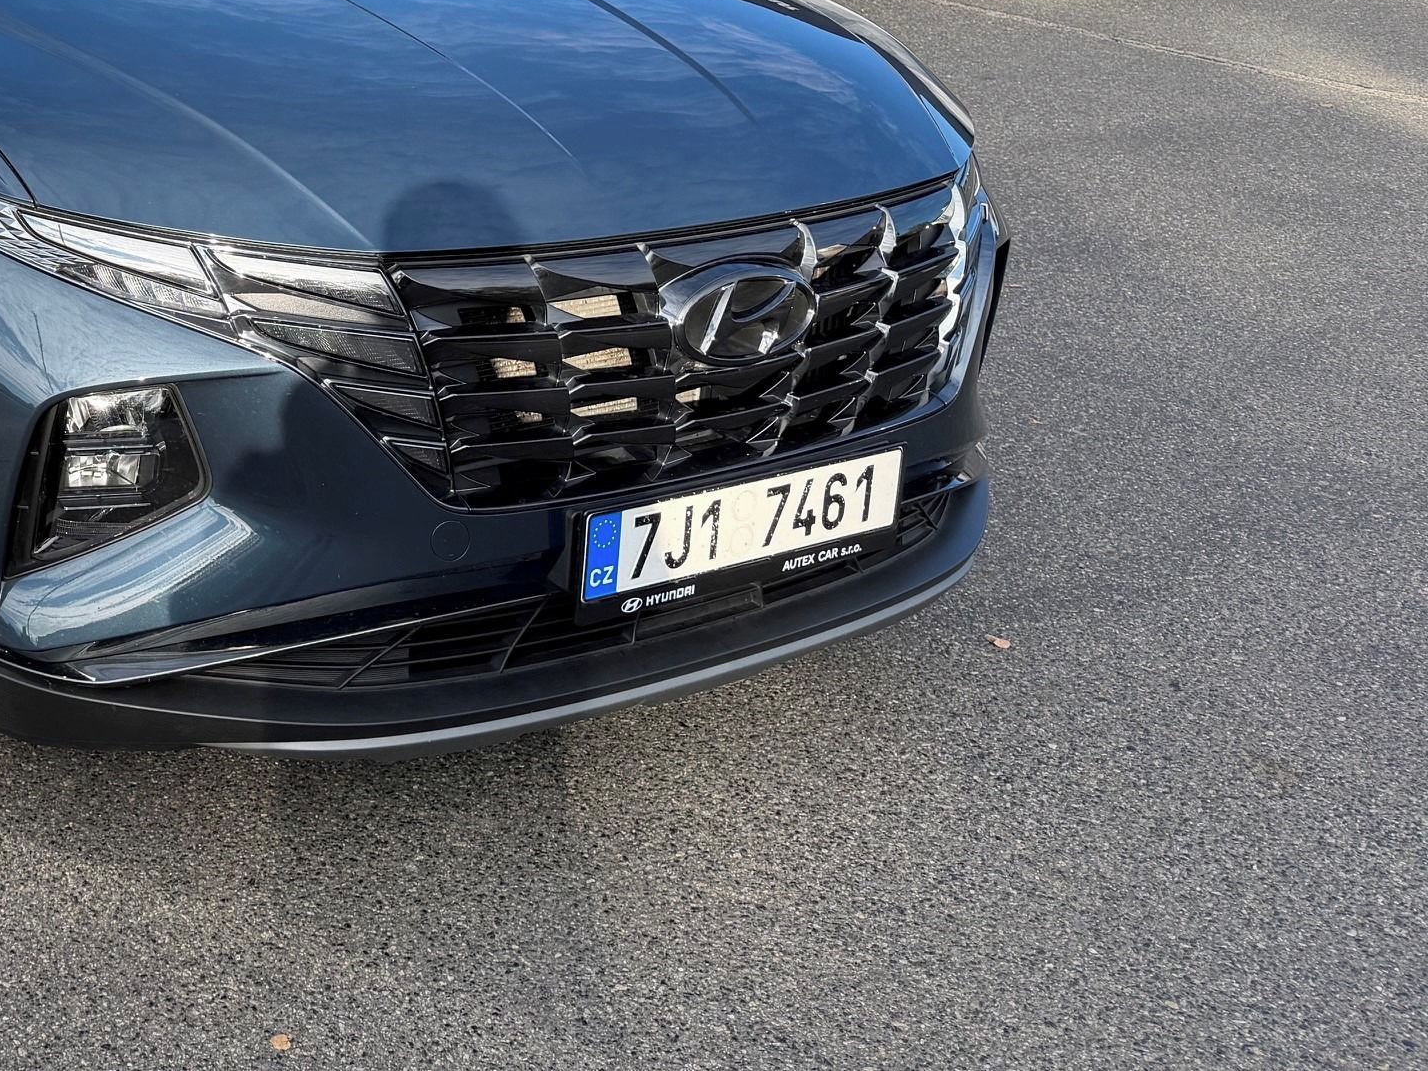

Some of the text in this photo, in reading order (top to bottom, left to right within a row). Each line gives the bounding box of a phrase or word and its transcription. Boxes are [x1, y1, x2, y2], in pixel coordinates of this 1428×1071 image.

[630, 464, 875, 580] 7J1 7461
[782, 543, 863, 572] AUTEX CAR s.r.o.
[589, 565, 614, 588] CZ
[645, 584, 696, 607] HYUNDAI
